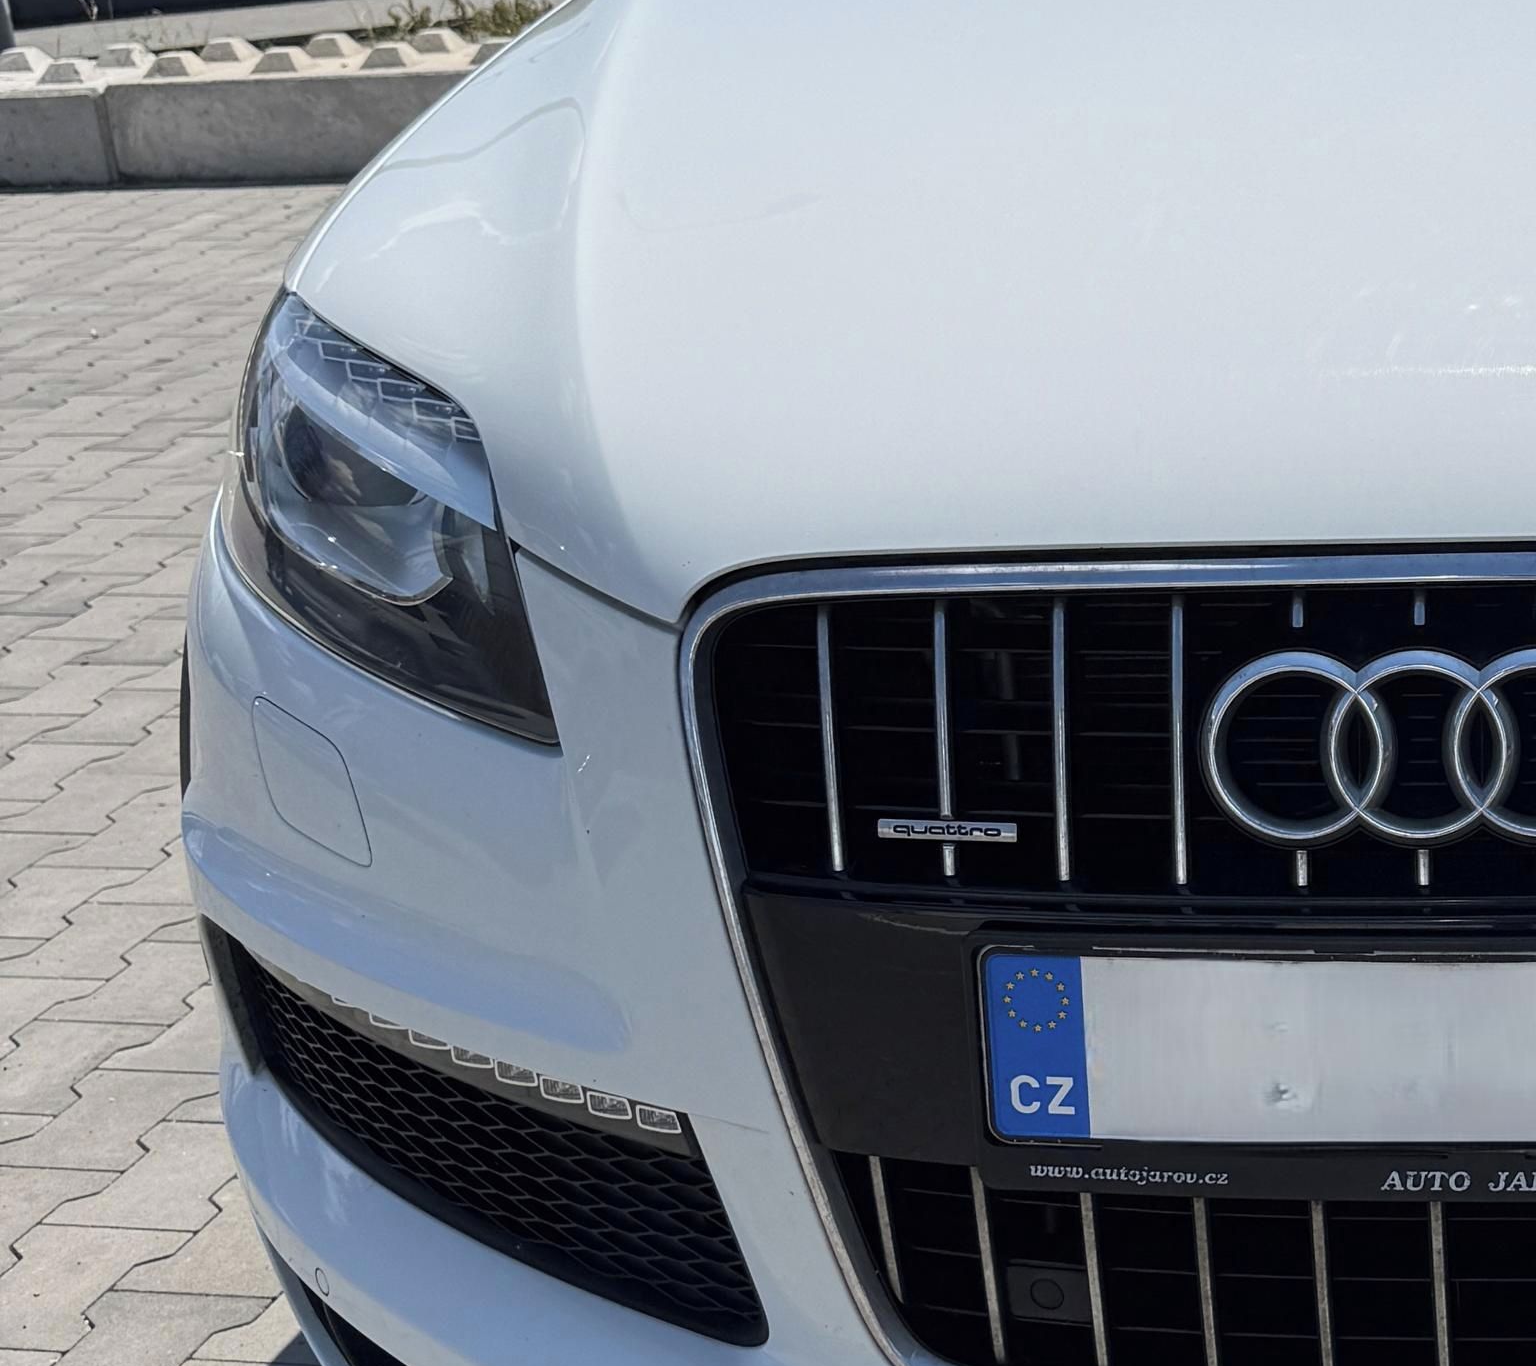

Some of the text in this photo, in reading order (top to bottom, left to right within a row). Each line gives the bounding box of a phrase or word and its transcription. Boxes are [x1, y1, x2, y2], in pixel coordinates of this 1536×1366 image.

[893, 824, 1001, 837] quattro
[1010, 1075, 1075, 1115] CZ
[1030, 1164, 1229, 1185] www.autojarov.cz
[1381, 1170, 1471, 1192] AUTO
